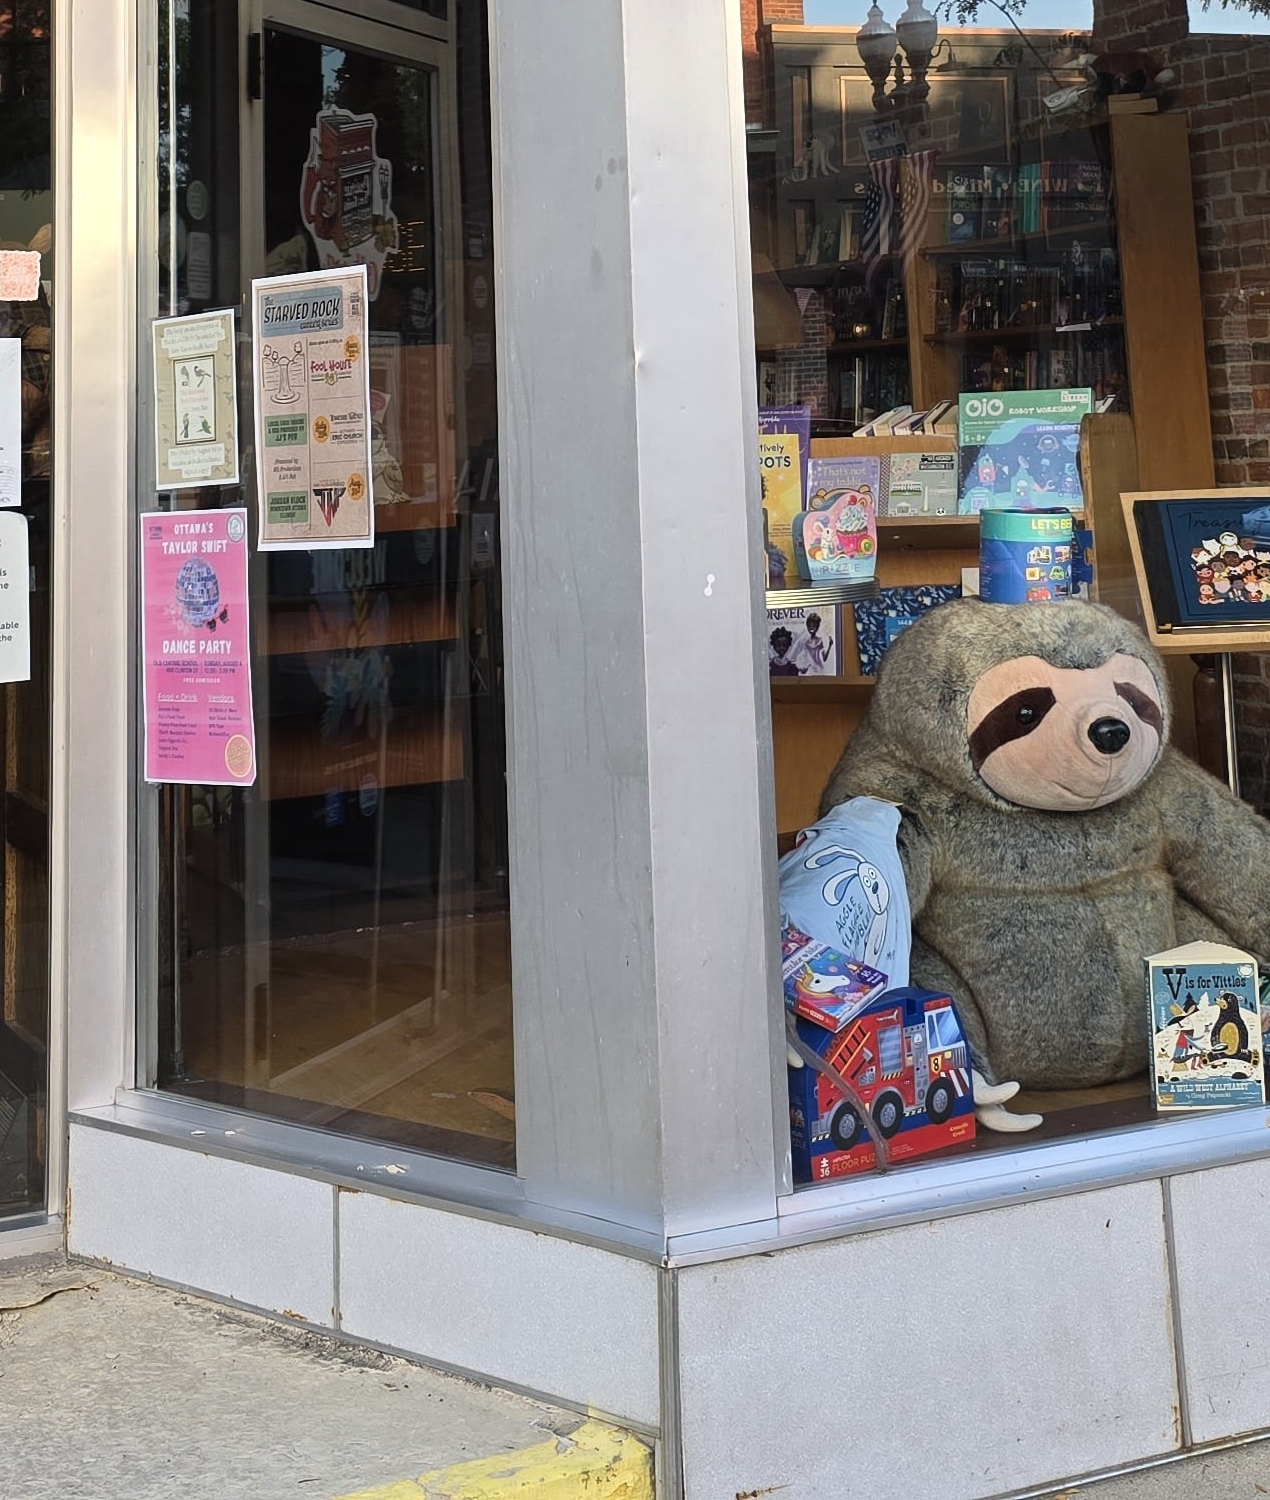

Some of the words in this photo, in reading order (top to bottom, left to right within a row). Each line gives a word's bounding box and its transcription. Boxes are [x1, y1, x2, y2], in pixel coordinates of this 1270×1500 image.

[264, 303, 308, 323] STARVED
[311, 298, 340, 319] ROCK
[1008, 407, 1033, 415] ROBOT
[1036, 405, 1077, 414] WORKSHOP
[174, 523, 214, 534] OTTAWA'S
[1032, 518, 1060, 530] LET'S
[162, 541, 197, 554] TAYLOR
[201, 539, 227, 553] SWIFT
[0, 569, 7, 577] is
[162, 641, 196, 654] DANCE
[199, 640, 232, 654] PARTY
[835, 896, 857, 933] AGGLE
[1162, 968, 1186, 1000] V
[1185, 977, 1195, 989] is
[1197, 976, 1211, 988] for
[1212, 975, 1247, 988] Vittles
[932, 1057, 939, 1071] 8
[1214, 1082, 1249, 1091] ALPHABET
[820, 1168, 830, 1178] 36
[832, 1159, 859, 1173] FLOOR
